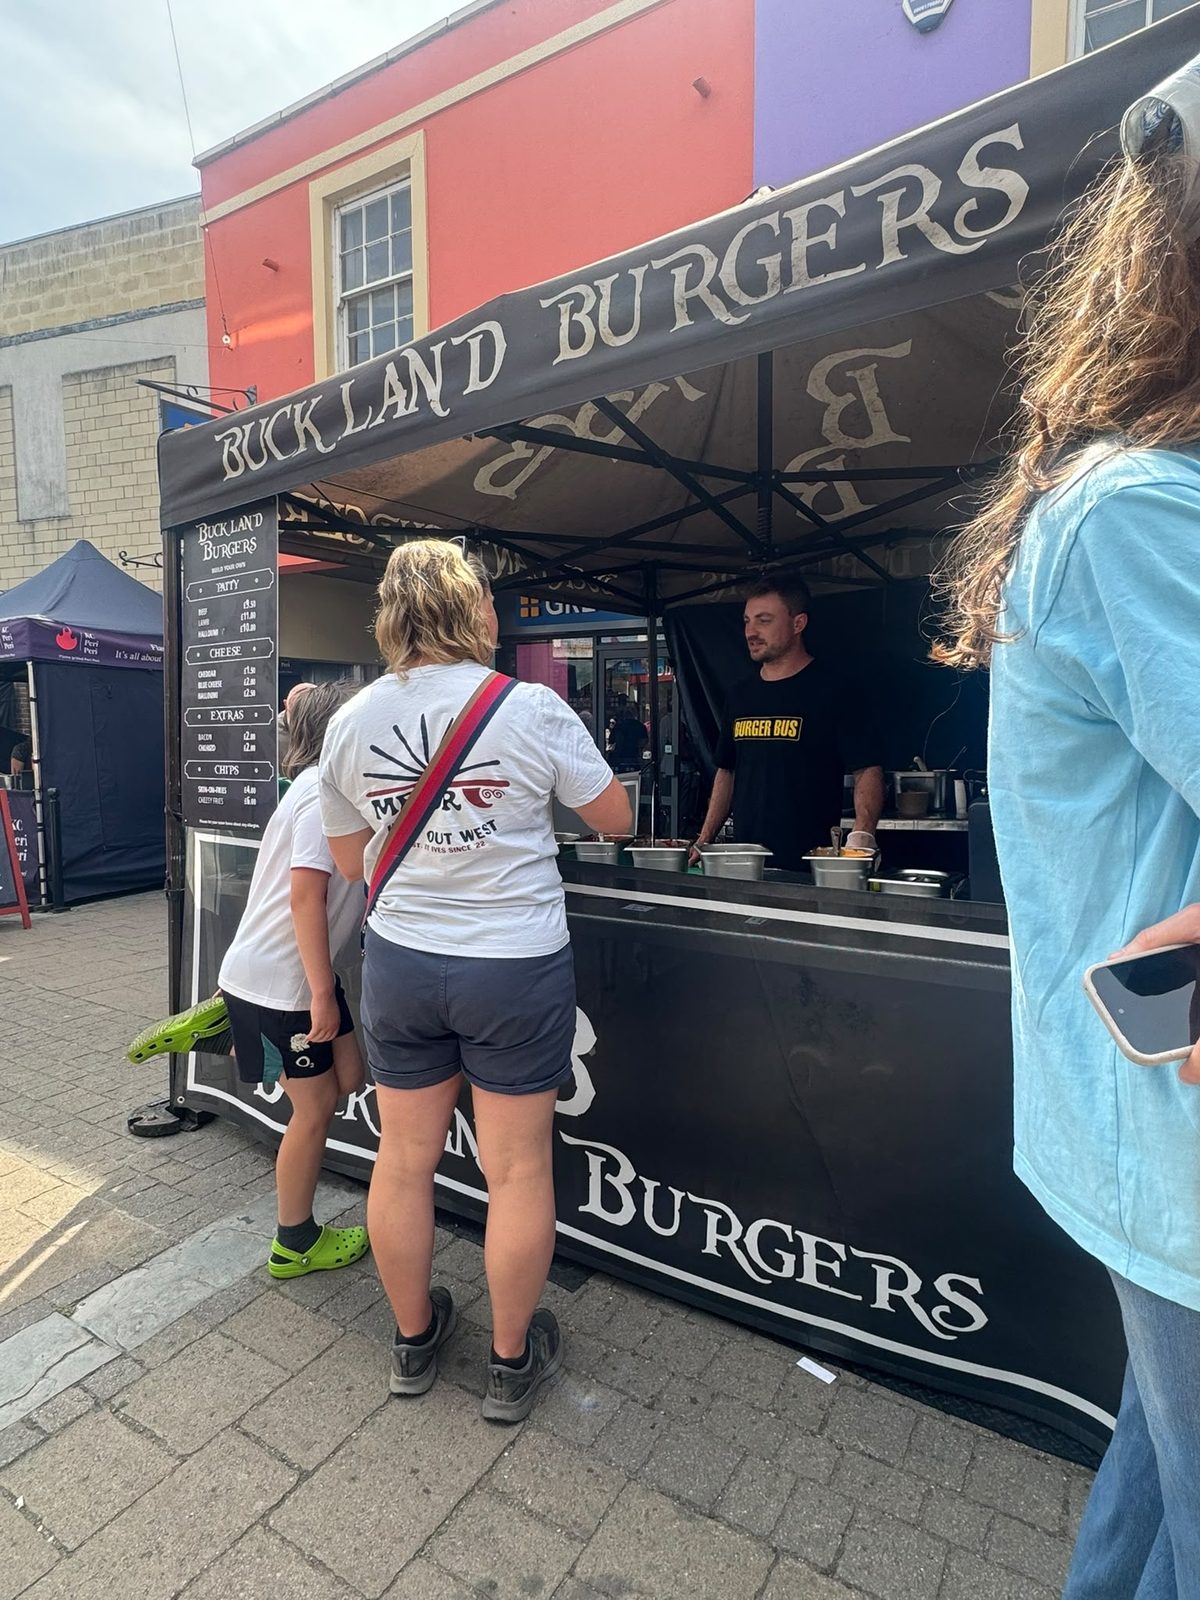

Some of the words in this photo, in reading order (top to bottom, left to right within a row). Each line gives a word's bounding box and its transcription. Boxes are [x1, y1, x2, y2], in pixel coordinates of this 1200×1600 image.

[215, 321, 508, 482] BUCKLAND
[539, 123, 1030, 367] BURGERS
[200, 537, 257, 561] BURGERS
[216, 579, 240, 592] PATTY
[4, 641, 14, 649] Peri
[115, 650, 127, 659] It's
[129, 651, 139, 660] all
[141, 652, 162, 662] about
[210, 646, 242, 658] CHEESE
[198, 670, 216, 678] CHEDDAR
[208, 680, 222, 688] CHEESE
[210, 710, 244, 722] EXTRAS
[735, 720, 771, 737] BURGER
[774, 720, 798, 737] BUS
[214, 765, 240, 775] CHIPS
[427, 830, 452, 845] OUT
[459, 819, 498, 843] WEST
[448, 845, 472, 853] SINCE
[559, 1130, 989, 1340] BURGERS
